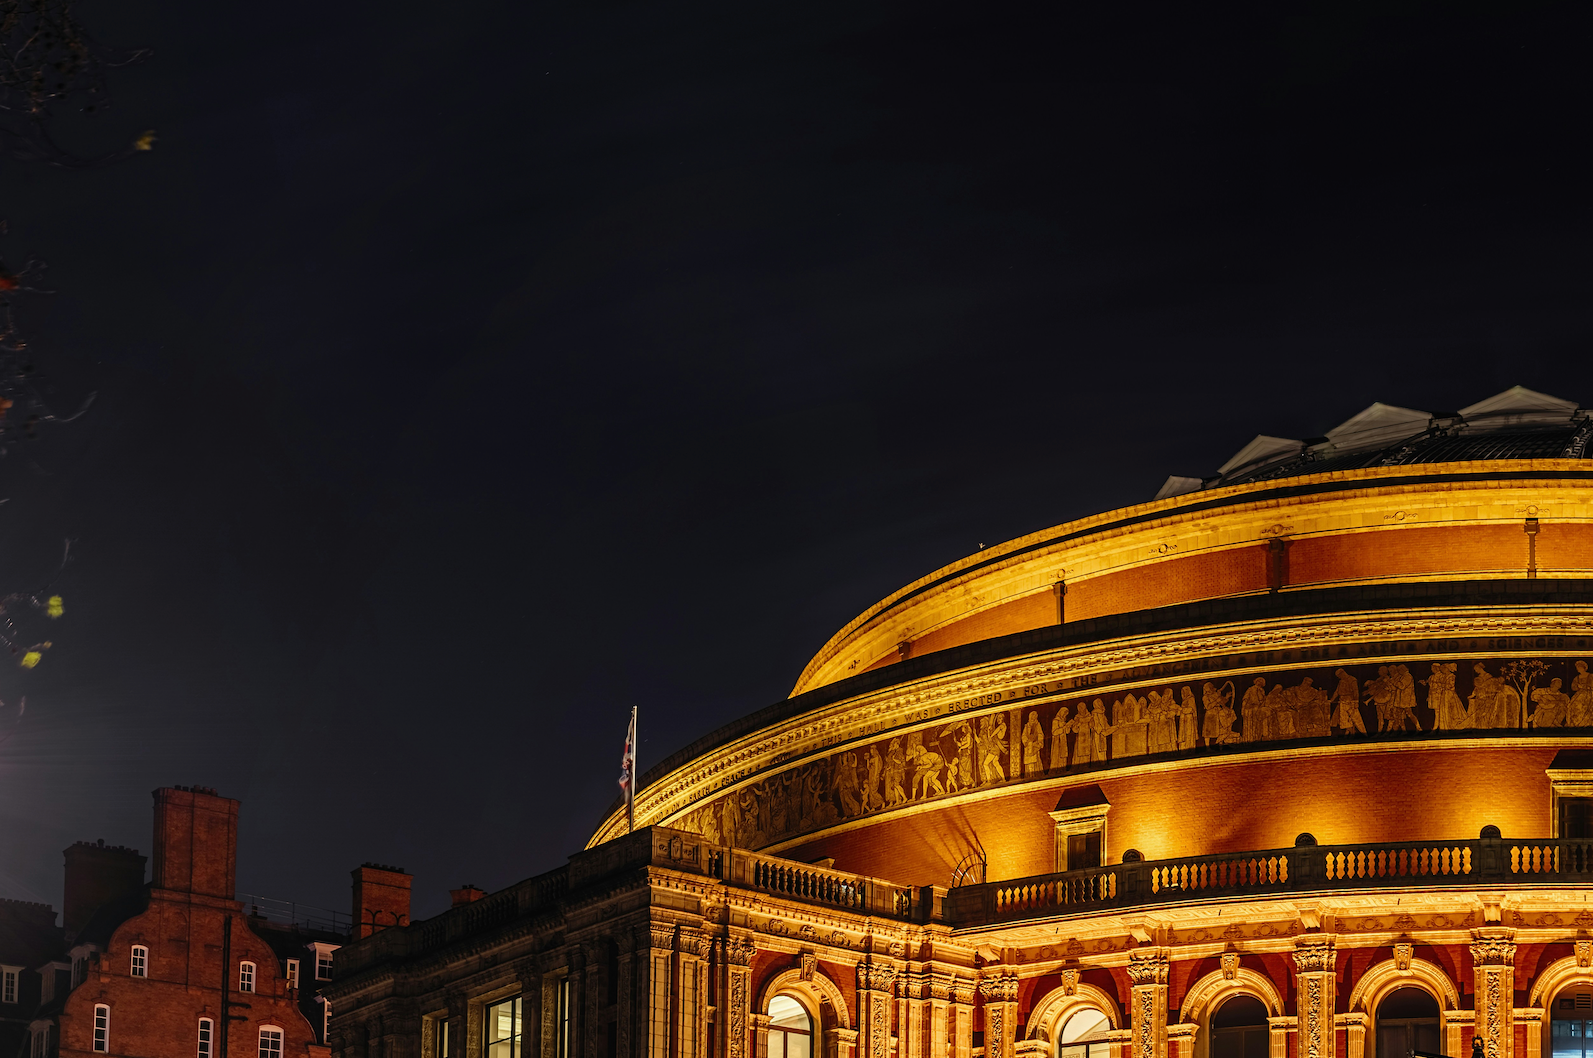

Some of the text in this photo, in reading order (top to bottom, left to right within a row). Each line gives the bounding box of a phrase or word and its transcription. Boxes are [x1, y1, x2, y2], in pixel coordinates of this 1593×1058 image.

[859, 721, 886, 736] HALL
[904, 709, 929, 721] WAS
[948, 692, 1002, 712] ERECTED
[1024, 684, 1049, 697] FOR
[1072, 674, 1097, 689] THE
[1122, 657, 1230, 680] ADVANCEMENT
[1425, 640, 1460, 652] AND
[1488, 638, 1564, 650] SCIENCES
